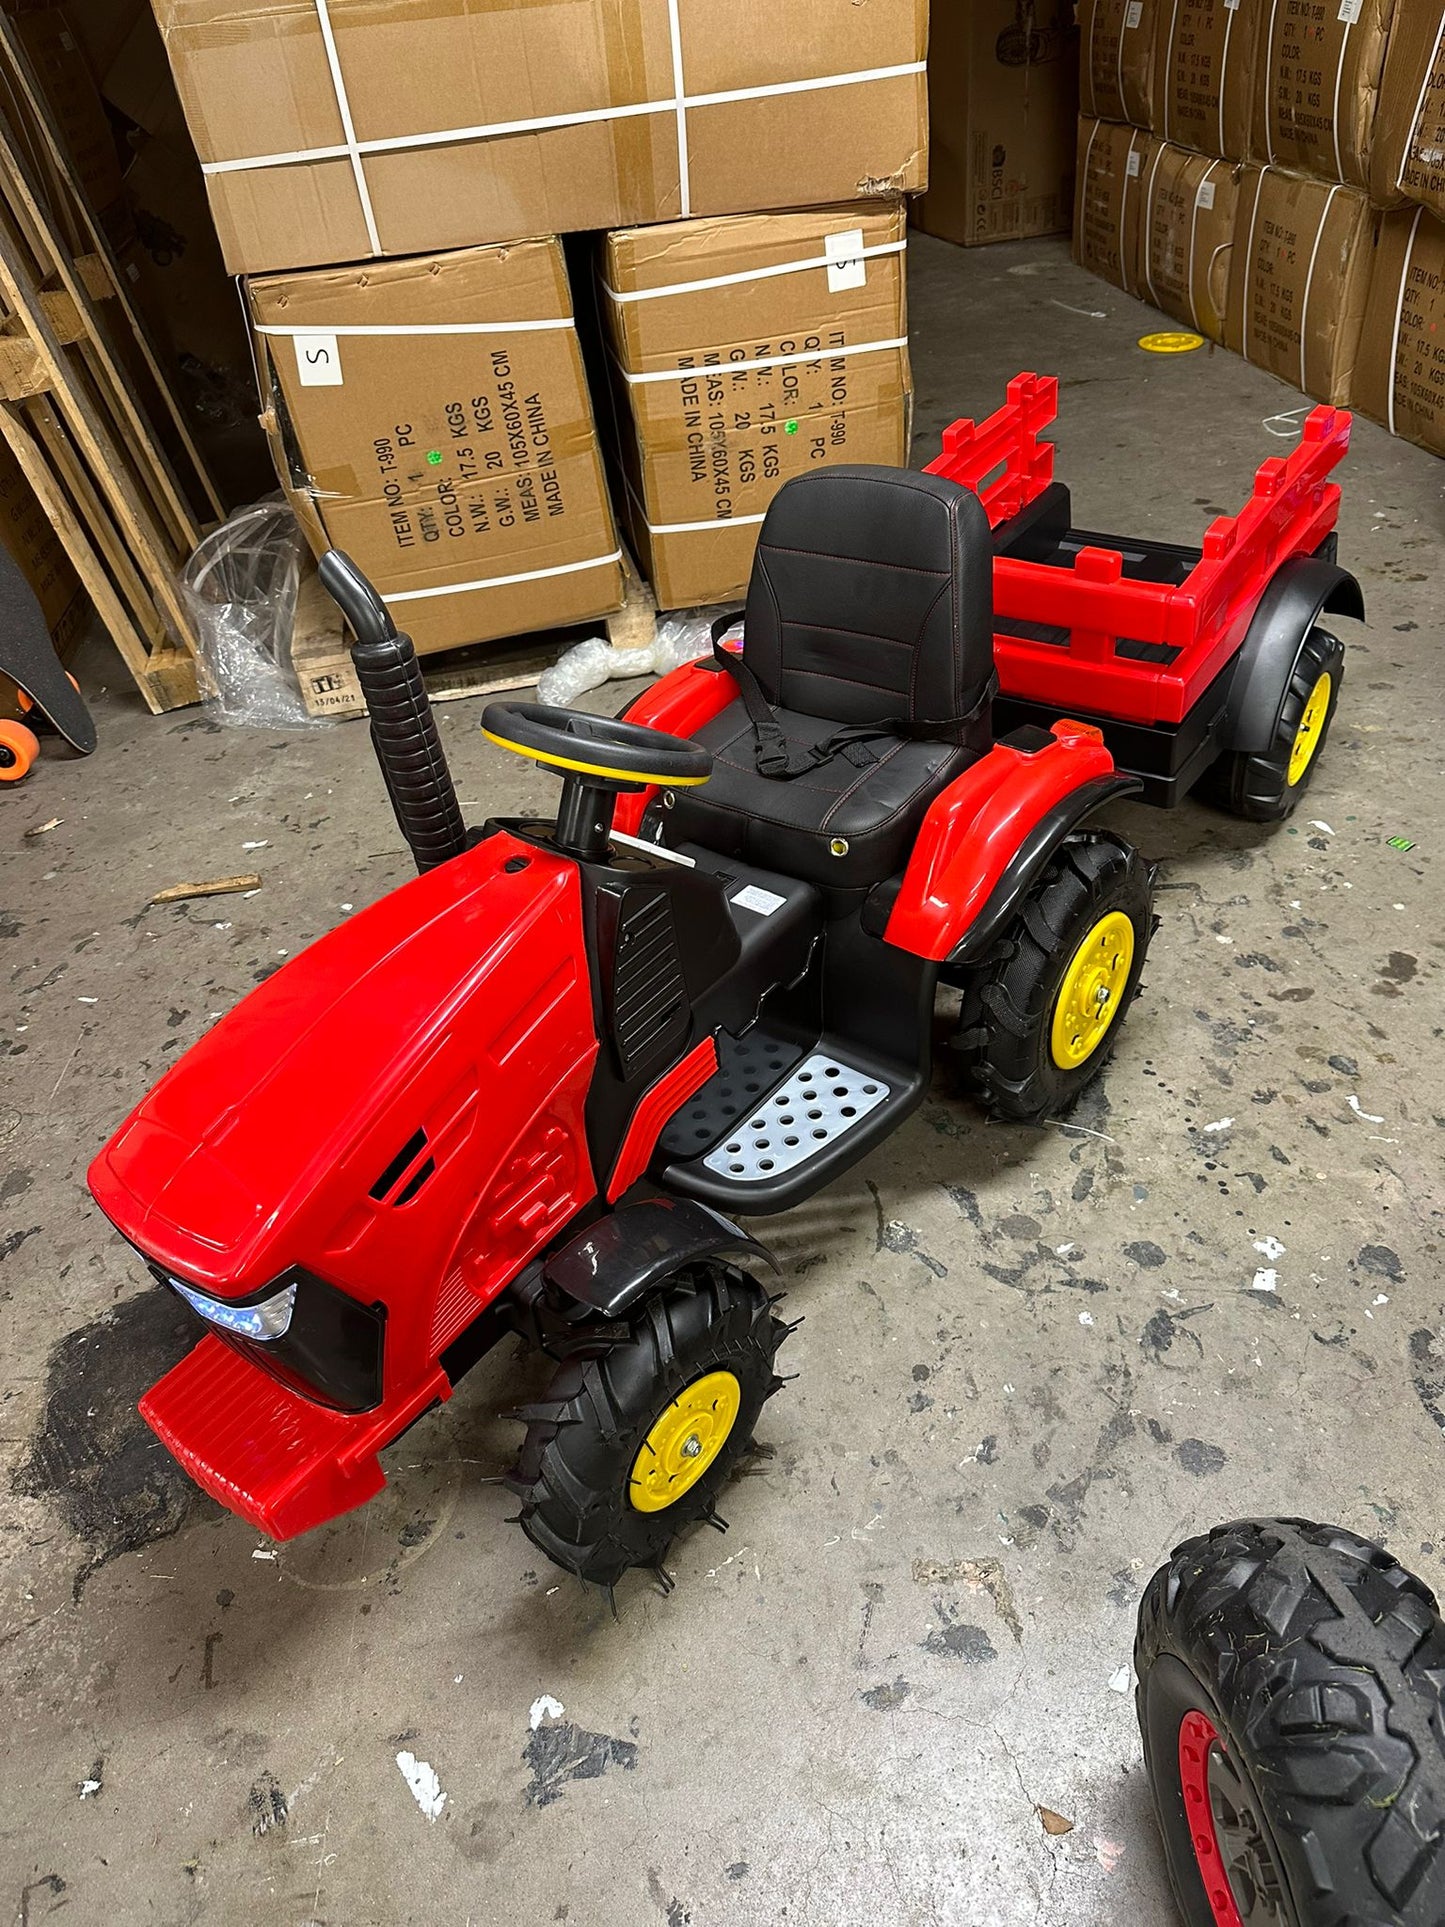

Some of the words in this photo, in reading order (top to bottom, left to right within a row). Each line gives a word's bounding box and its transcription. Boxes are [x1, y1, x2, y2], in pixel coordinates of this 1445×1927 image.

[992, 168, 1003, 200] BSCI
[1409, 266, 1428, 285] ITEM
[1429, 298, 1435, 312] 1
[306, 349, 329, 364] S
[490, 350, 511, 377] CM
[804, 336, 822, 375] QY:
[829, 331, 846, 372] ITM
[1416, 339, 1430, 357] 17.5
[704, 353, 725, 407] MAS:
[780, 341, 800, 406] CLOR:
[1395, 371, 1409, 389] EAS:
[1414, 360, 1423, 376] 20
[808, 402, 825, 411] 1
[831, 376, 847, 406] NO:
[445, 402, 468, 439] KGS
[471, 396, 494, 433] KGS
[497, 381, 530, 467] 105X60X45
[524, 393, 550, 447] CHINA
[684, 409, 702, 427] IN
[735, 412, 751, 430] 20
[759, 402, 778, 435] 17.5
[831, 411, 847, 446] T-990
[395, 424, 415, 447] PC
[811, 437, 826, 459] PC
[373, 438, 398, 474] T-990
[456, 448, 479, 479] 17.5
[484, 451, 504, 470] 20
[536, 450, 554, 469] IN
[687, 431, 708, 482] CHINA
[708, 412, 730, 495] 105X60X45
[738, 449, 755, 483] KGS
[763, 443, 780, 479] KGS
[383, 478, 404, 507] NO:
[407, 473, 424, 482] 1
[540, 470, 564, 517] MADE
[437, 477, 465, 537] COLOR:
[468, 494, 491, 533] N.W.:
[493, 488, 515, 527] G.W.:
[516, 477, 540, 522] MEAS:
[390, 510, 415, 548] ITEM
[417, 507, 440, 542] QTY:
